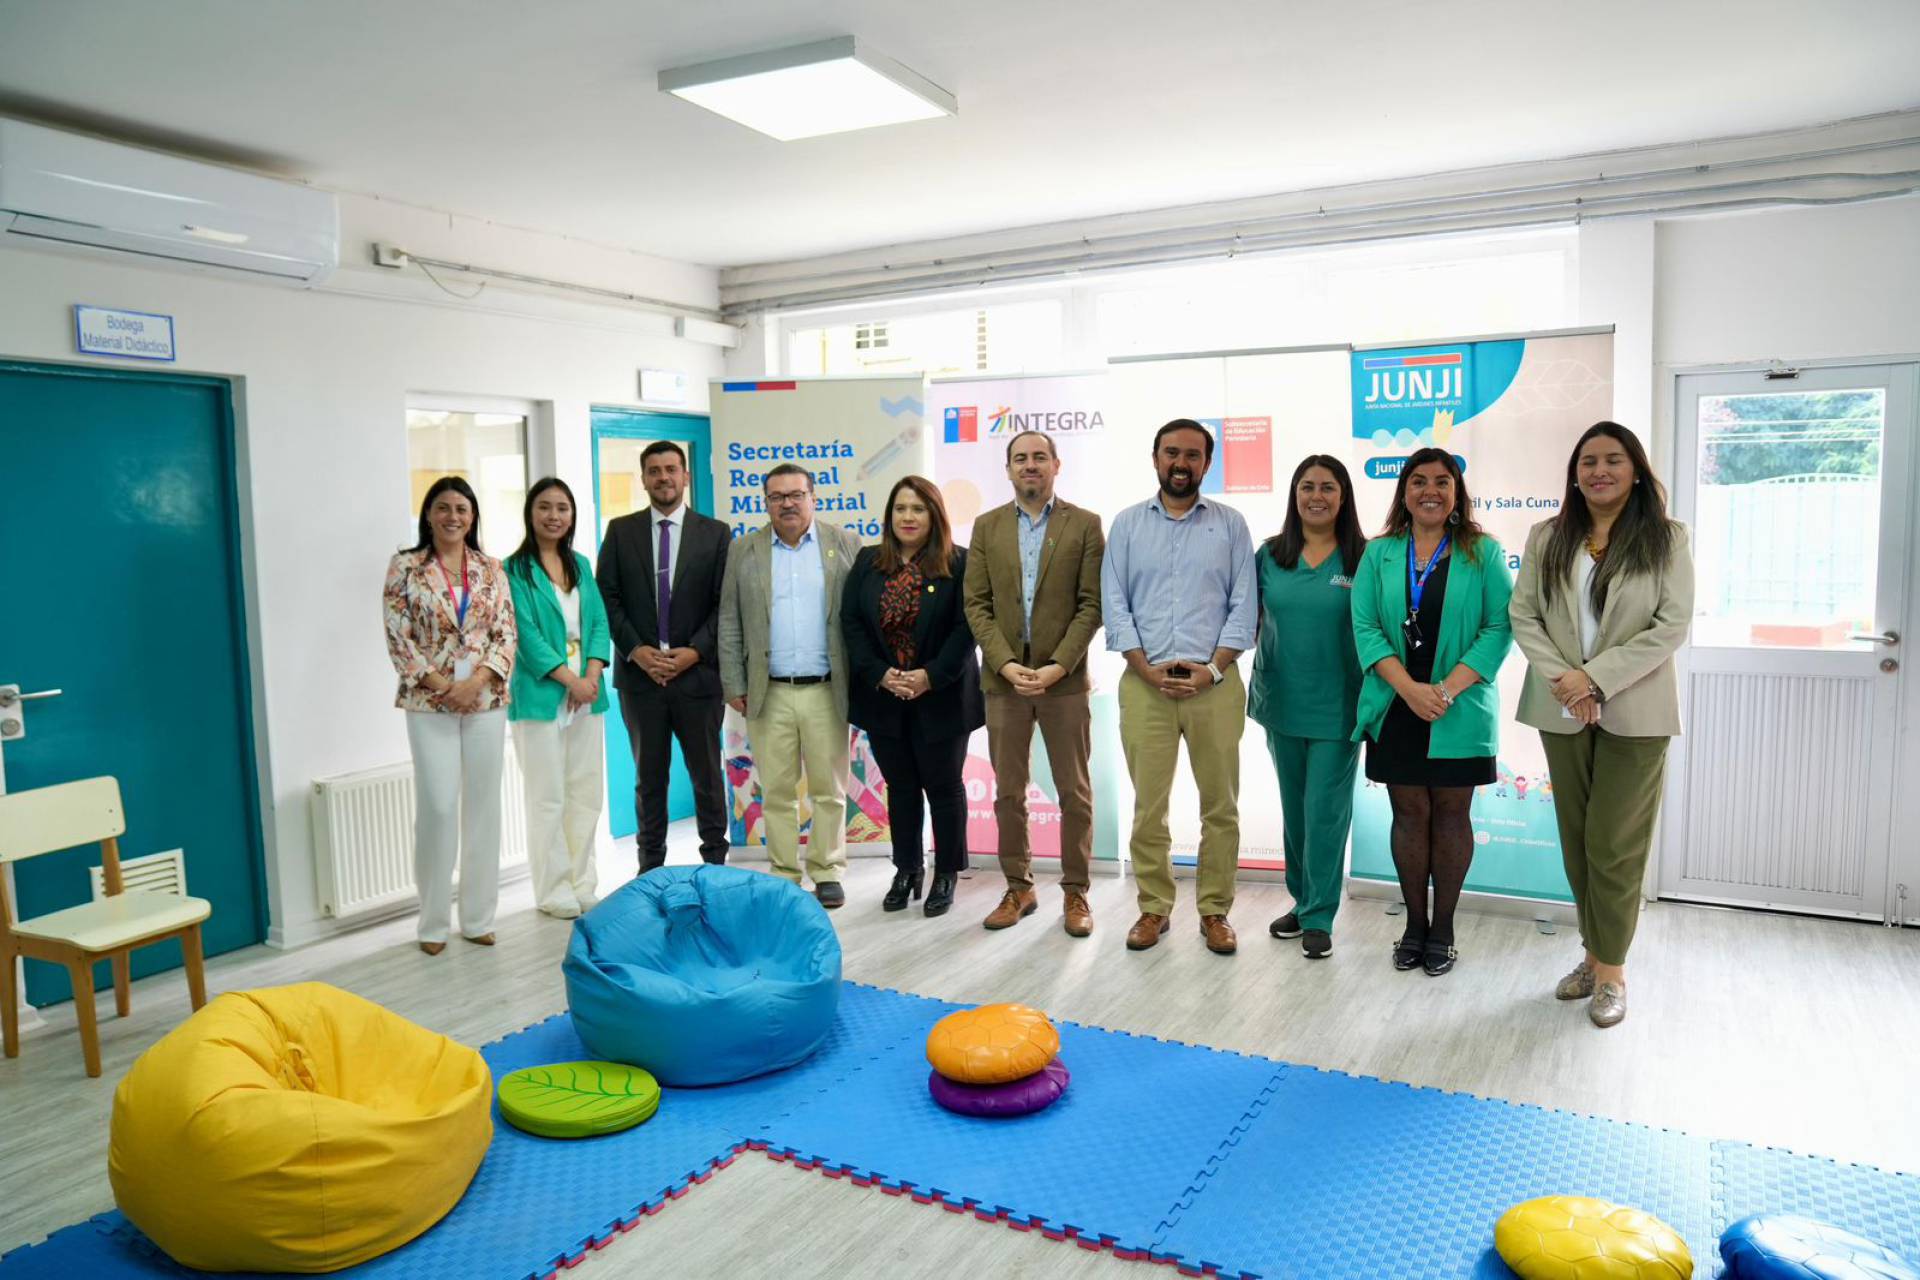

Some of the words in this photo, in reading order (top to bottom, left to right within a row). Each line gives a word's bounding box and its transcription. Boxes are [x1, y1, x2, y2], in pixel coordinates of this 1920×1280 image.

[106, 314, 145, 336] Bodega
[83, 331, 123, 350] Material
[1364, 367, 1463, 403] JUNJI
[1008, 410, 1105, 432] INTEGRA
[727, 439, 854, 461] Secretaría
[1484, 499, 1492, 511] y
[1495, 496, 1522, 509] Sala
[1526, 496, 1560, 508] Cuna
